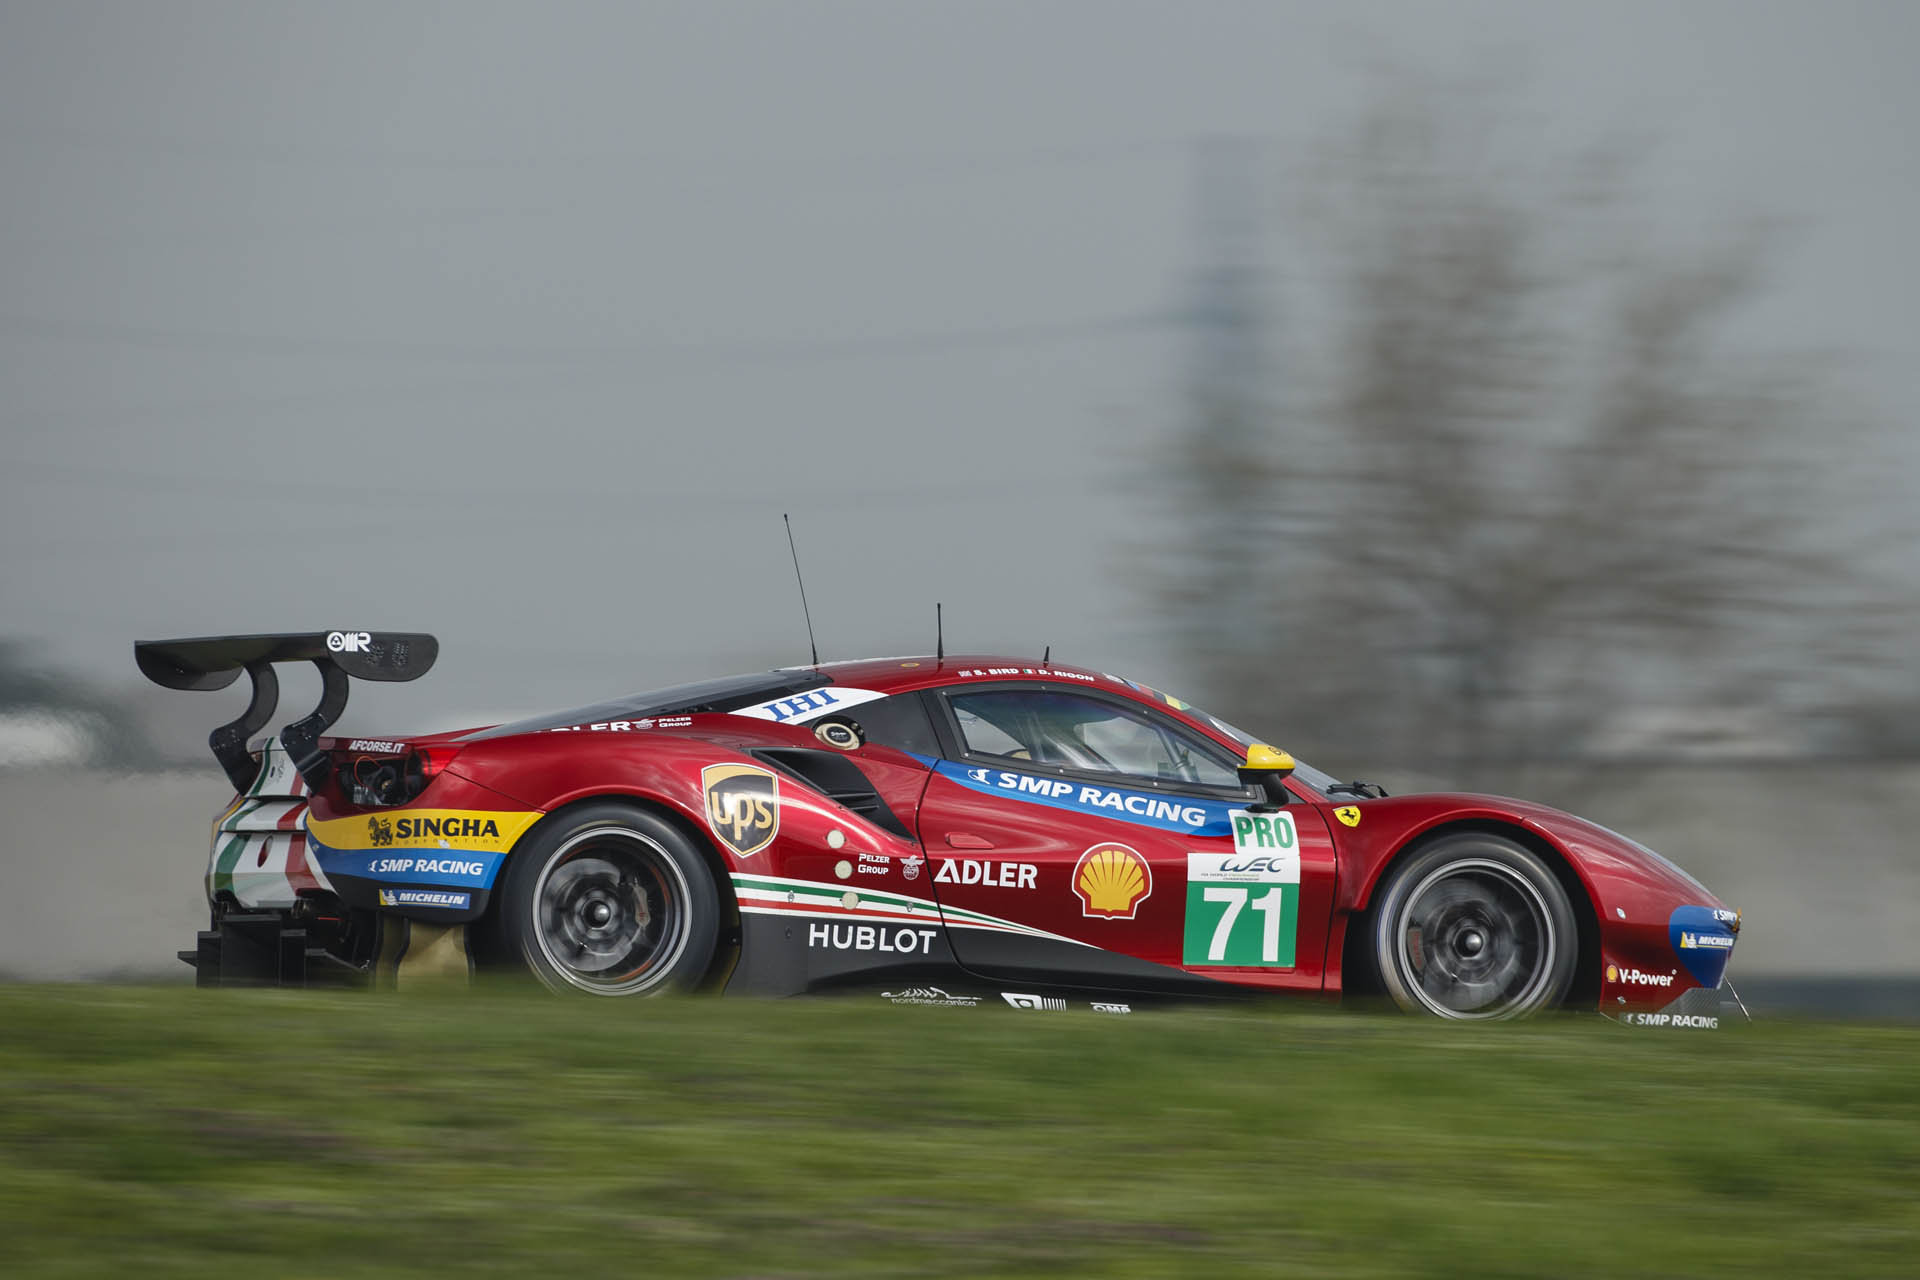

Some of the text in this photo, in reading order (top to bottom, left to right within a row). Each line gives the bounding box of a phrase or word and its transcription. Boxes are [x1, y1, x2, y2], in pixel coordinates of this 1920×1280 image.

[1054, 670, 1095, 681] RIGON
[762, 689, 841, 722] IHI
[348, 739, 405, 754] AFCORSE.IT
[998, 772, 1206, 827] SMP RACING
[710, 790, 773, 841] ups
[395, 817, 500, 838] SINGHA
[1234, 815, 1294, 849] PRO
[379, 858, 484, 876] SMP RACING
[858, 853, 890, 864] PELZER
[1219, 857, 1286, 873] WEC
[857, 864, 889, 875] GROUP
[933, 858, 1038, 889] ADLER
[399, 892, 465, 905] MICHELIN
[1203, 887, 1282, 962] 71
[808, 923, 937, 954] HUBLOT
[891, 997, 977, 1008] nordmeccanica
[1637, 1013, 1719, 1029] SMP RACING
